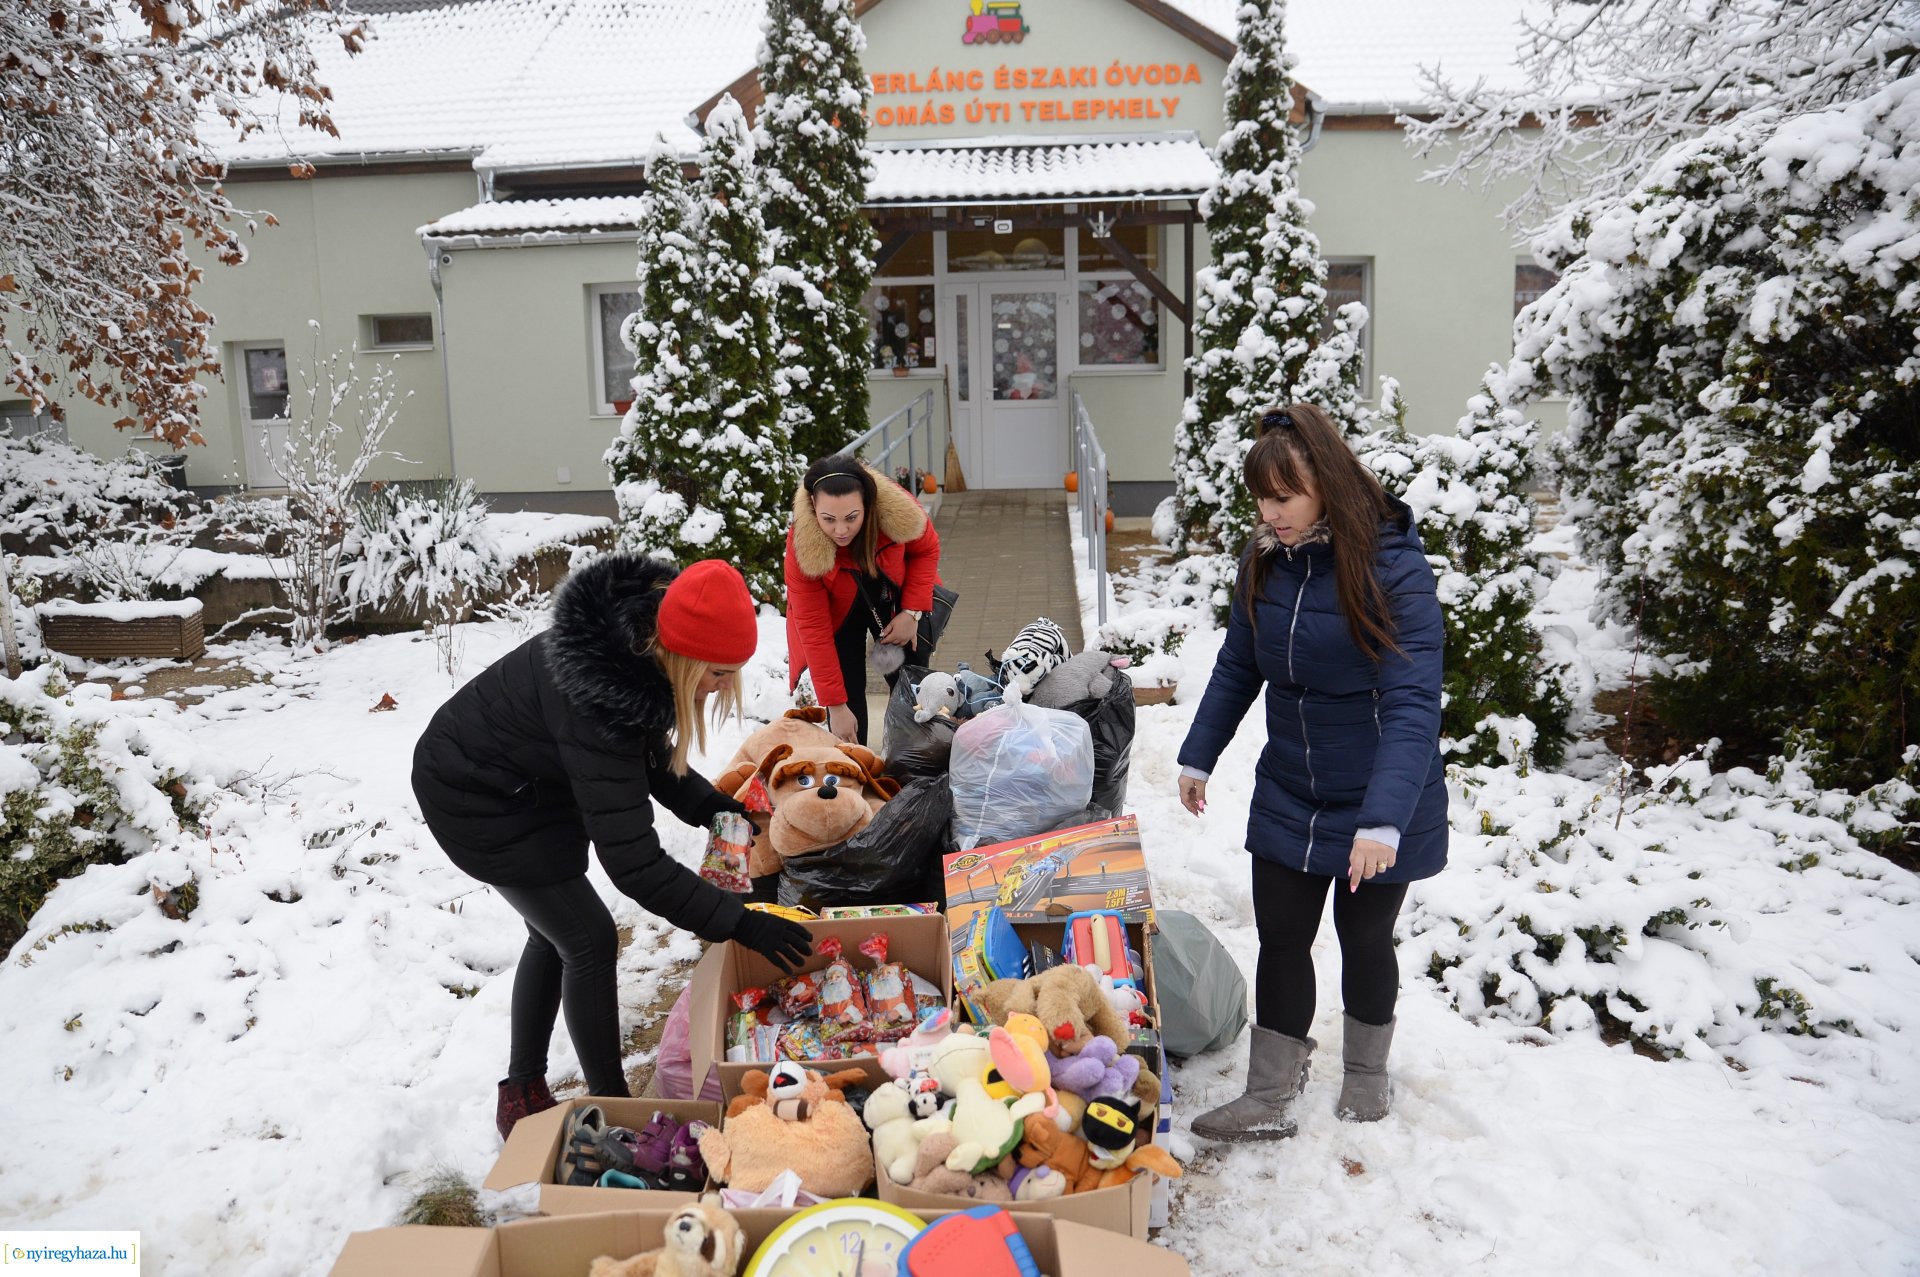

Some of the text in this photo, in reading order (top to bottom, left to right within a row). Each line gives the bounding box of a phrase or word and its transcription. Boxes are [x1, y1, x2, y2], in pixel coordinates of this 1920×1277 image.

[871, 60, 1202, 94] ERLÁNC ÉSZAKI ÓVODA
[871, 97, 1181, 127] OMÁS ÚTI TELEPHELY
[839, 1231, 861, 1254] 12
